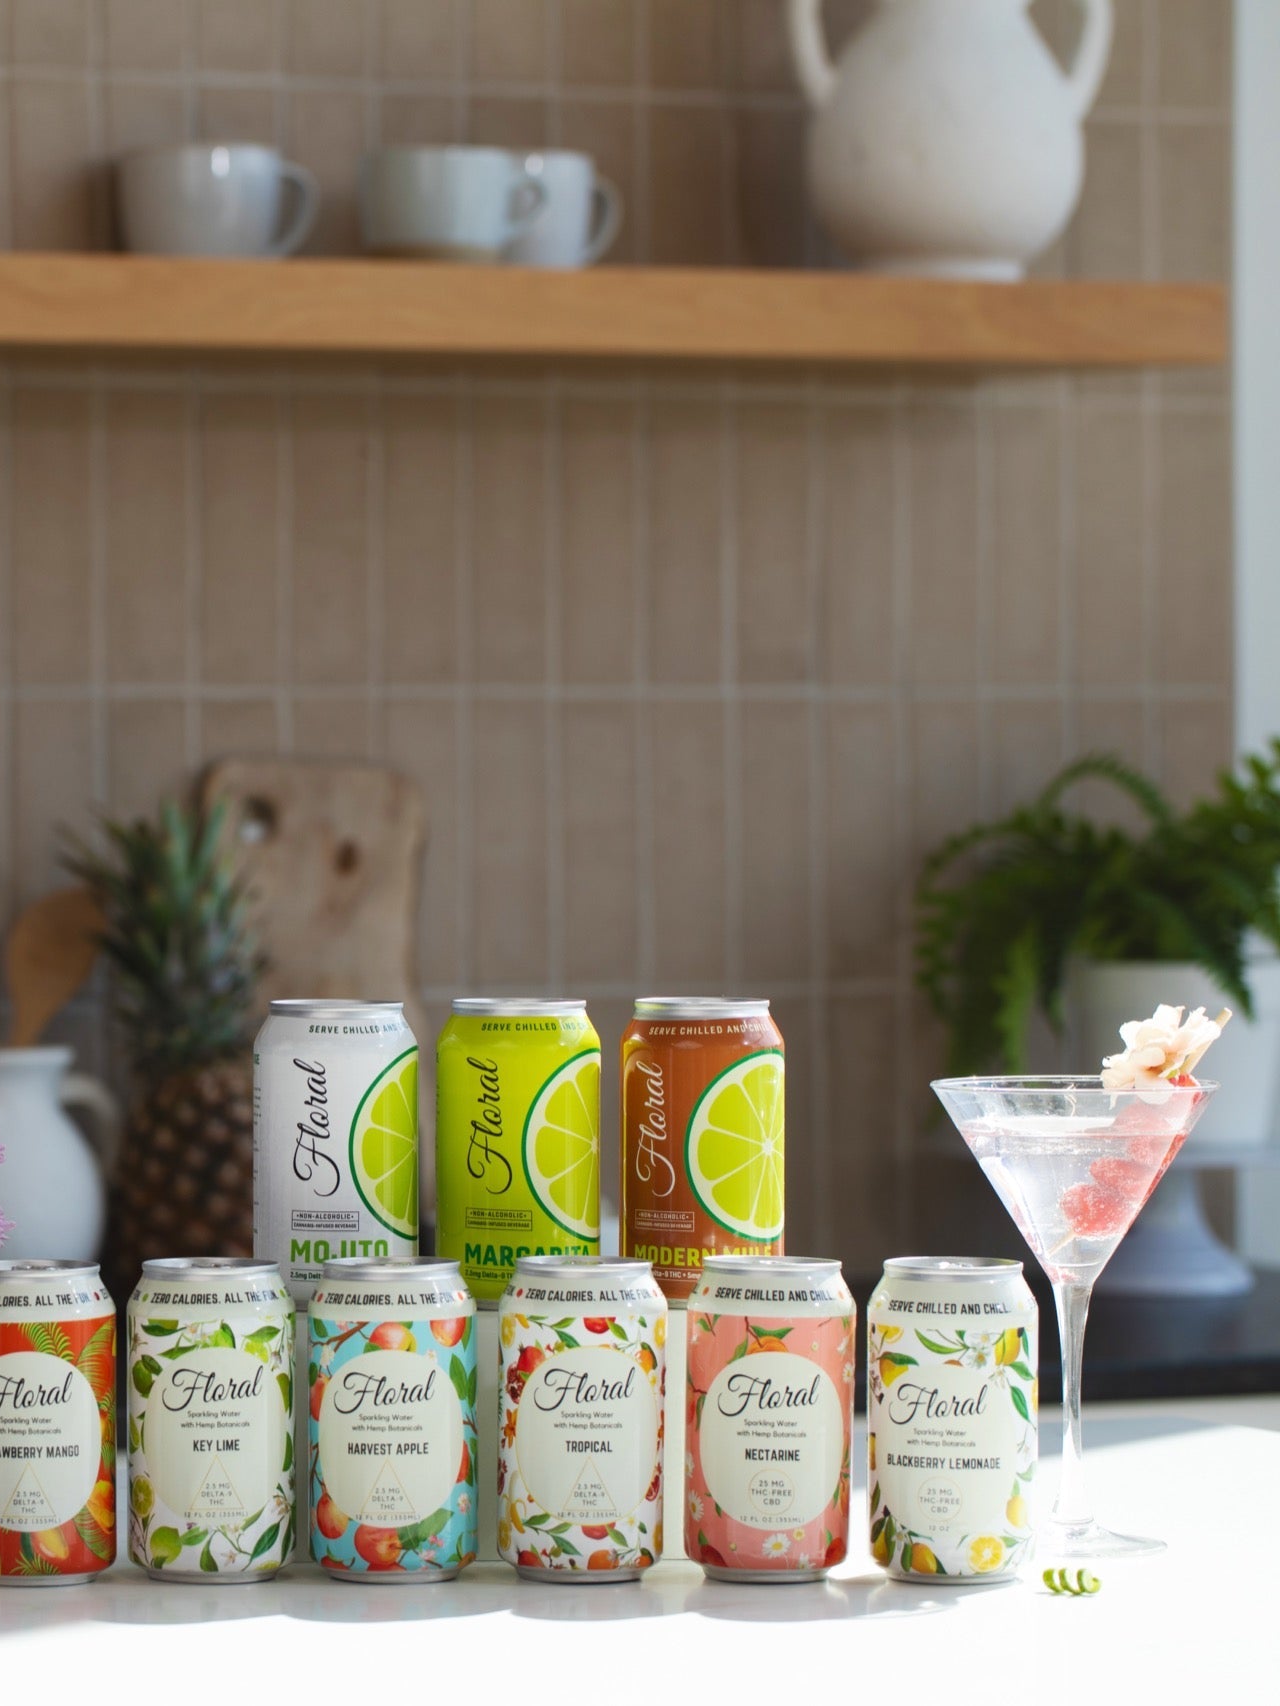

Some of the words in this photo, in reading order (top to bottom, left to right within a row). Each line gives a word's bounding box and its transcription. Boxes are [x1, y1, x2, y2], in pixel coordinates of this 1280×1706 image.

[309, 1025, 339, 1034] SERVE
[343, 1025, 379, 1034] CHILLED
[481, 1022, 511, 1031] SERVE
[515, 1022, 557, 1031] CHILLED
[649, 1026, 676, 1036] SERVE
[679, 1025, 723, 1035] CHILLED
[726, 1024, 744, 1034] AND
[293, 1058, 340, 1197] Floral
[466, 1057, 512, 1195] Floral
[635, 1060, 675, 1197] Floral
[290, 1239, 388, 1264] MOJITO
[634, 1244, 716, 1267] MODERN
[290, 1271, 307, 1280] 2.5mg
[35, 1295, 53, 1306] ALL
[55, 1294, 73, 1305] THE
[150, 1292, 171, 1304] ZERO
[172, 1293, 221, 1305] CALORIES.
[224, 1292, 243, 1304] ALL
[245, 1291, 261, 1302] THE
[324, 1293, 345, 1305] ZERO
[345, 1293, 394, 1306] CALORIES.
[397, 1293, 417, 1305] ALL
[420, 1293, 437, 1304] THE
[525, 1288, 546, 1300] ZERO
[547, 1289, 596, 1301] CALORIES.
[600, 1290, 617, 1301] ALL
[620, 1289, 635, 1300] THE
[715, 1287, 742, 1300] SERVE
[744, 1289, 785, 1301] CHILLED
[788, 1290, 808, 1302] AND
[888, 1300, 914, 1313] SERVE
[916, 1302, 957, 1314] CHILLED
[960, 1303, 980, 1315] AND
[162, 1365, 263, 1411] Floral
[333, 1369, 436, 1414] Floral
[534, 1366, 635, 1411] Floral
[717, 1374, 820, 1416] Floral
[888, 1384, 986, 1425] Floral
[0, 1416, 30, 1425] Sparkling
[31, 1416, 52, 1424] Water
[187, 1411, 218, 1419] Sparkling
[359, 1414, 390, 1422] Sparkling
[561, 1411, 591, 1419] Sparkling
[744, 1419, 775, 1428] Sparkling
[8, 1428, 27, 1436] Hemp
[913, 1428, 944, 1437] Sparkling
[46, 1445, 80, 1458] MANGO
[193, 1440, 213, 1452] KEY
[216, 1439, 240, 1452] LIME
[347, 1442, 392, 1455] HARVEST
[396, 1442, 429, 1455] APPLE
[566, 1440, 613, 1453] TROPICAL
[745, 1448, 800, 1461] NECTARINE
[887, 1453, 945, 1469] BLACKBERRY
[949, 1457, 1001, 1470] LEMONADE
